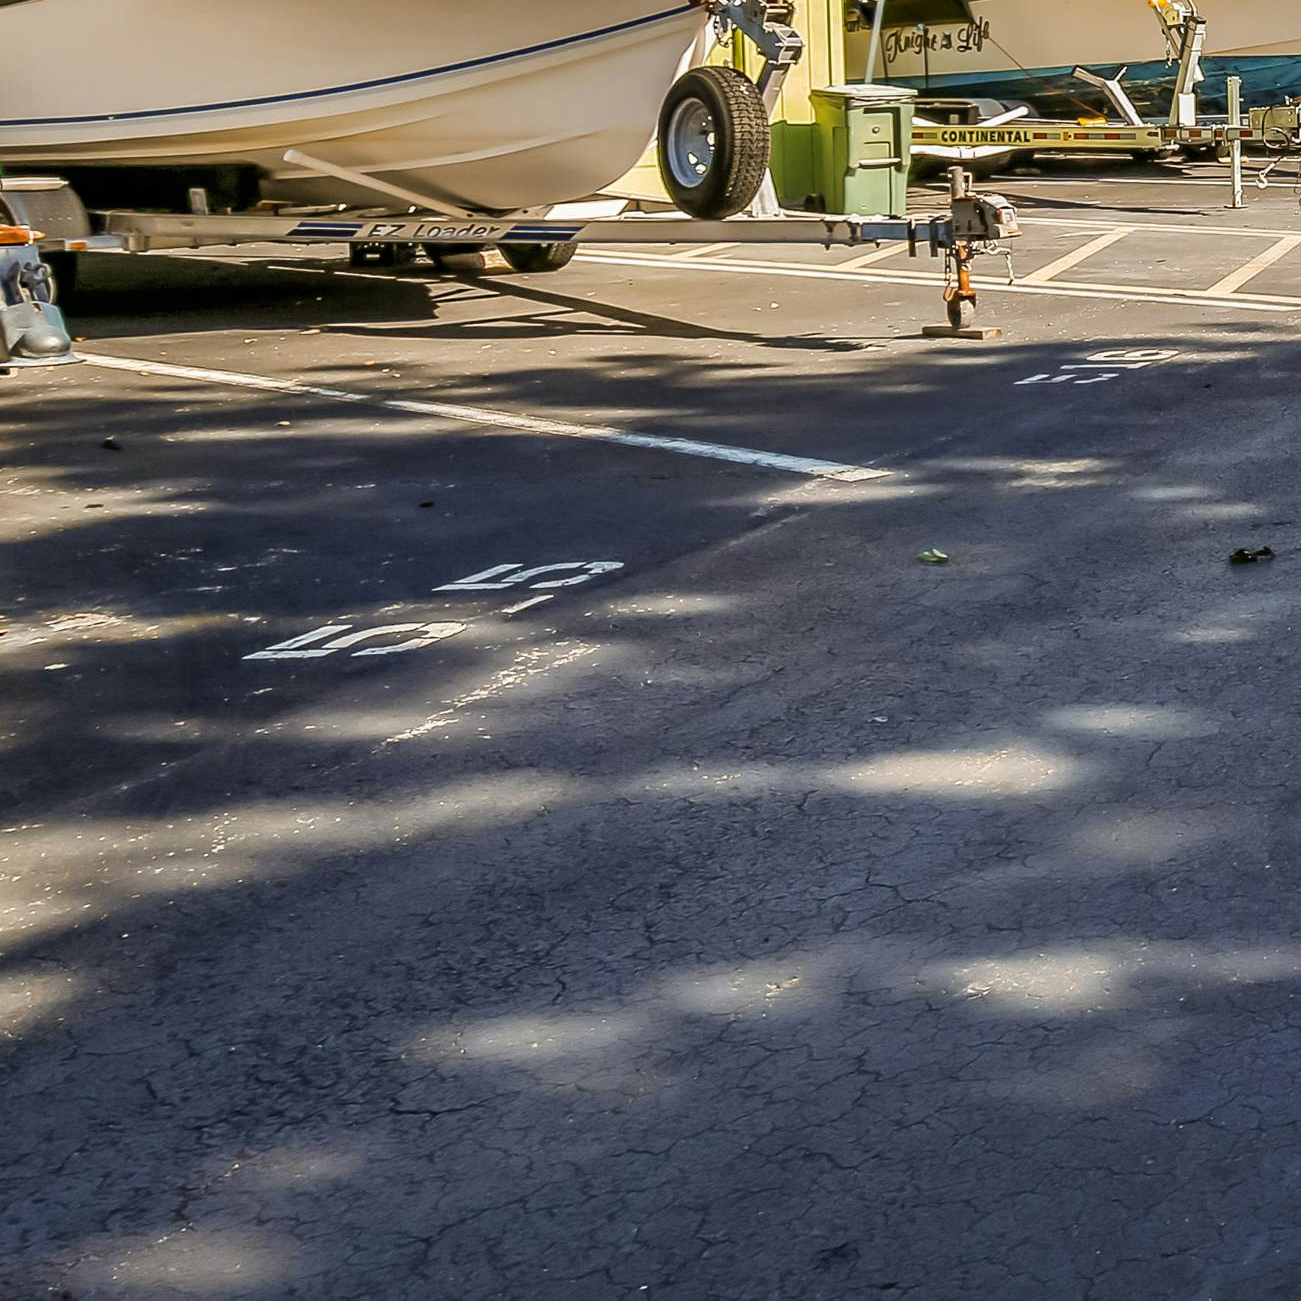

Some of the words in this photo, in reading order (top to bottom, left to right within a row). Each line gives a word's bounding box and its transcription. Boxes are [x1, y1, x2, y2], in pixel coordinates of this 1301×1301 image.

[940, 130, 1031, 143] CONTINENTAL
[367, 223, 407, 238] EZ
[412, 222, 501, 239] Loader
